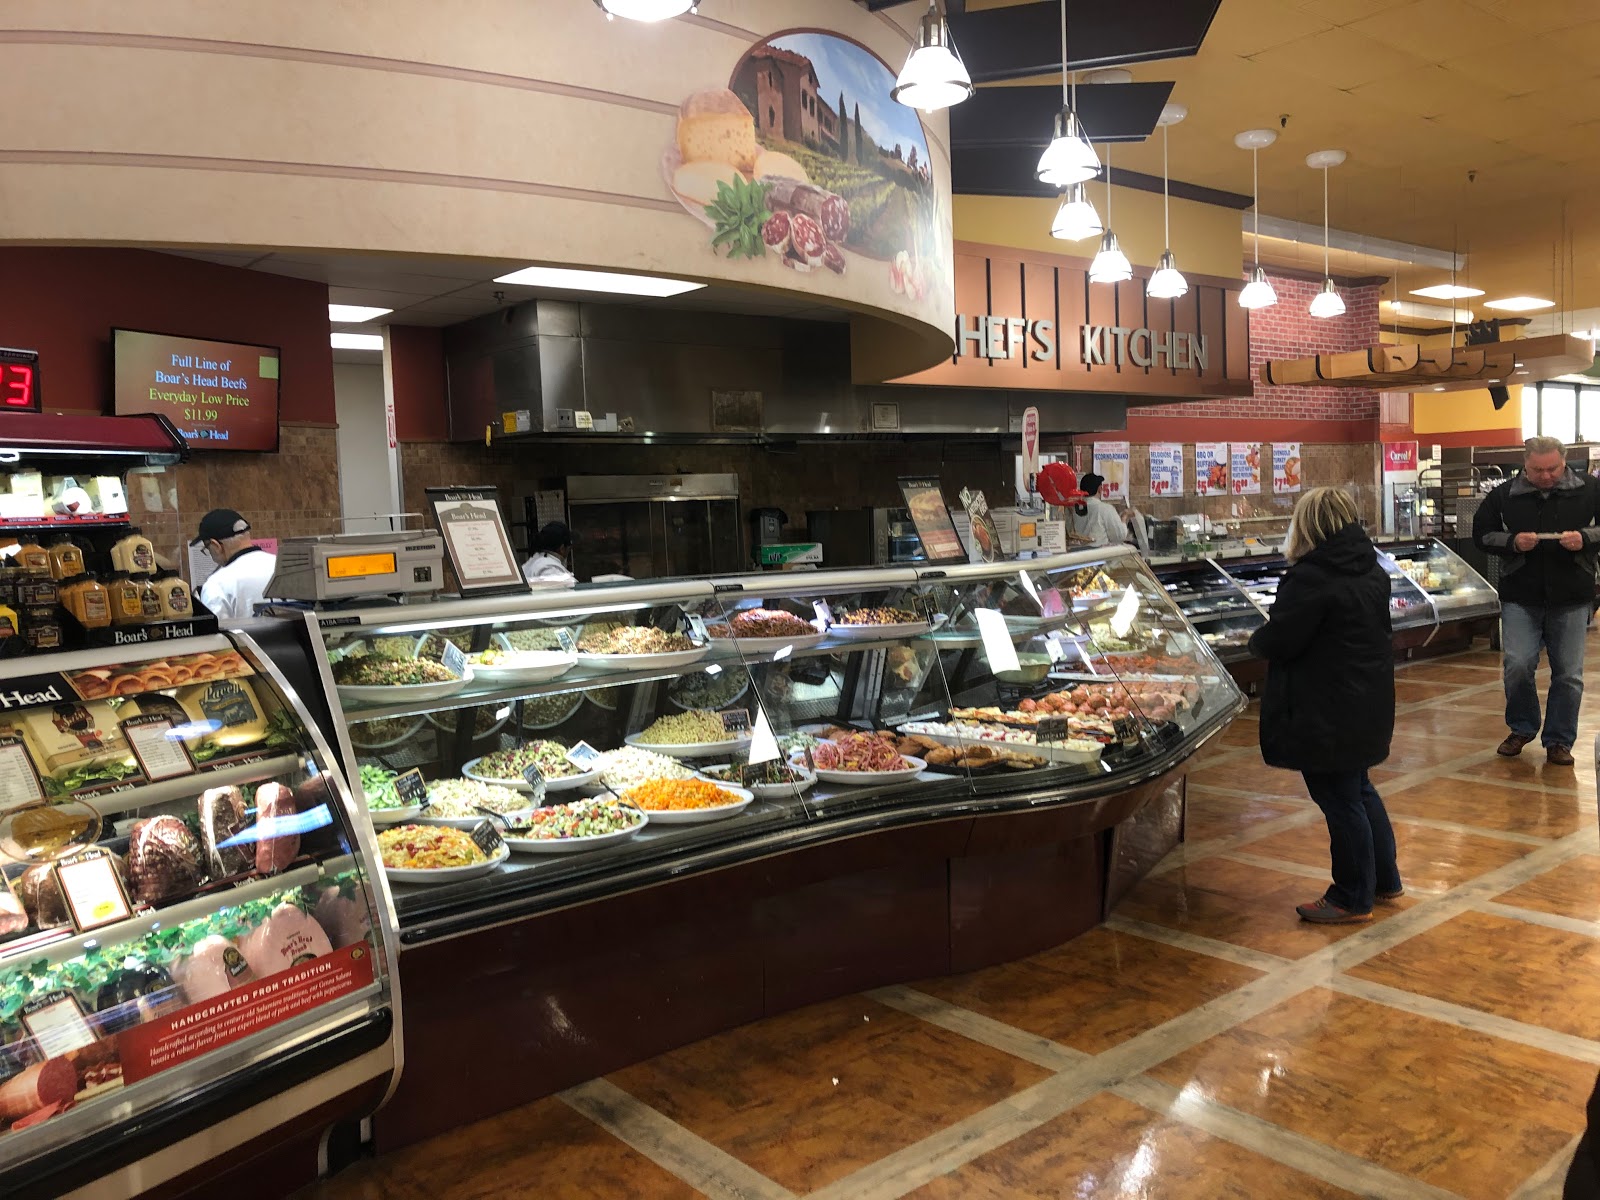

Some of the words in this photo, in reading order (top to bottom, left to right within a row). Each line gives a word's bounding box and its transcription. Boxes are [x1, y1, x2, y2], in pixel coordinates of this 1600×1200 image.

[955, 314, 1054, 361] HEF'S
[1082, 324, 1208, 370] KITCHEN
[171, 354, 192, 368] Full
[195, 357, 218, 371] Line
[219, 360, 232, 372] of
[155, 370, 190, 385] Boar's
[192, 374, 218, 388] Head
[221, 376, 247, 390] Beefs
[149, 388, 198, 406] Everyday
[201, 392, 223, 405] Low
[225, 393, 250, 407] Price
[184, 408, 218, 421] $11.99
[209, 430, 229, 440] Head
[1196, 451, 1207, 459] BBQ
[1207, 451, 1214, 459] OR
[1390, 450, 1408, 461] Carvel
[114, 628, 148, 645] Boar's
[165, 622, 194, 638] Head
[0, 684, 63, 709] Head
[170, 993, 250, 1031] HANDCRAFTED
[252, 982, 279, 999] FROM
[282, 962, 332, 987] TRADITION
[149, 1034, 188, 1057] Handcrafted
[188, 1024, 217, 1040] according
